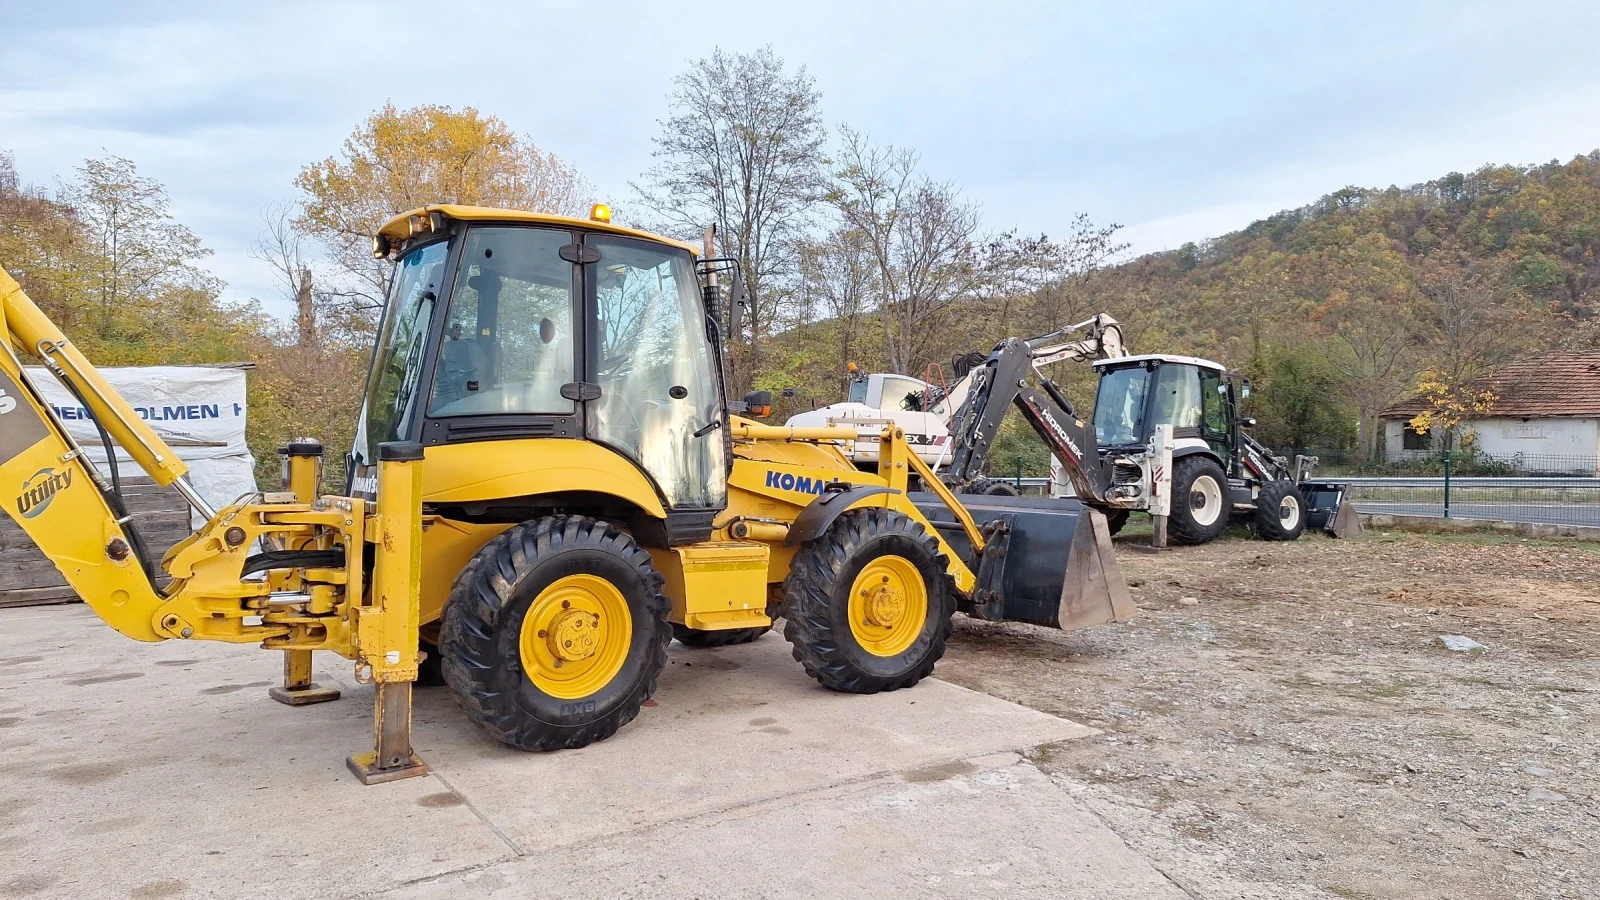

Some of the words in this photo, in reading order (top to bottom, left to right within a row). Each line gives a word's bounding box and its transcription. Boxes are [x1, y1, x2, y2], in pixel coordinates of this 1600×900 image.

[135, 403, 219, 421] OLMEN
[905, 434, 921, 444] EX
[1041, 405, 1085, 461] HIDROMEK
[16, 467, 72, 515] Utility
[561, 701, 595, 717] BKT
